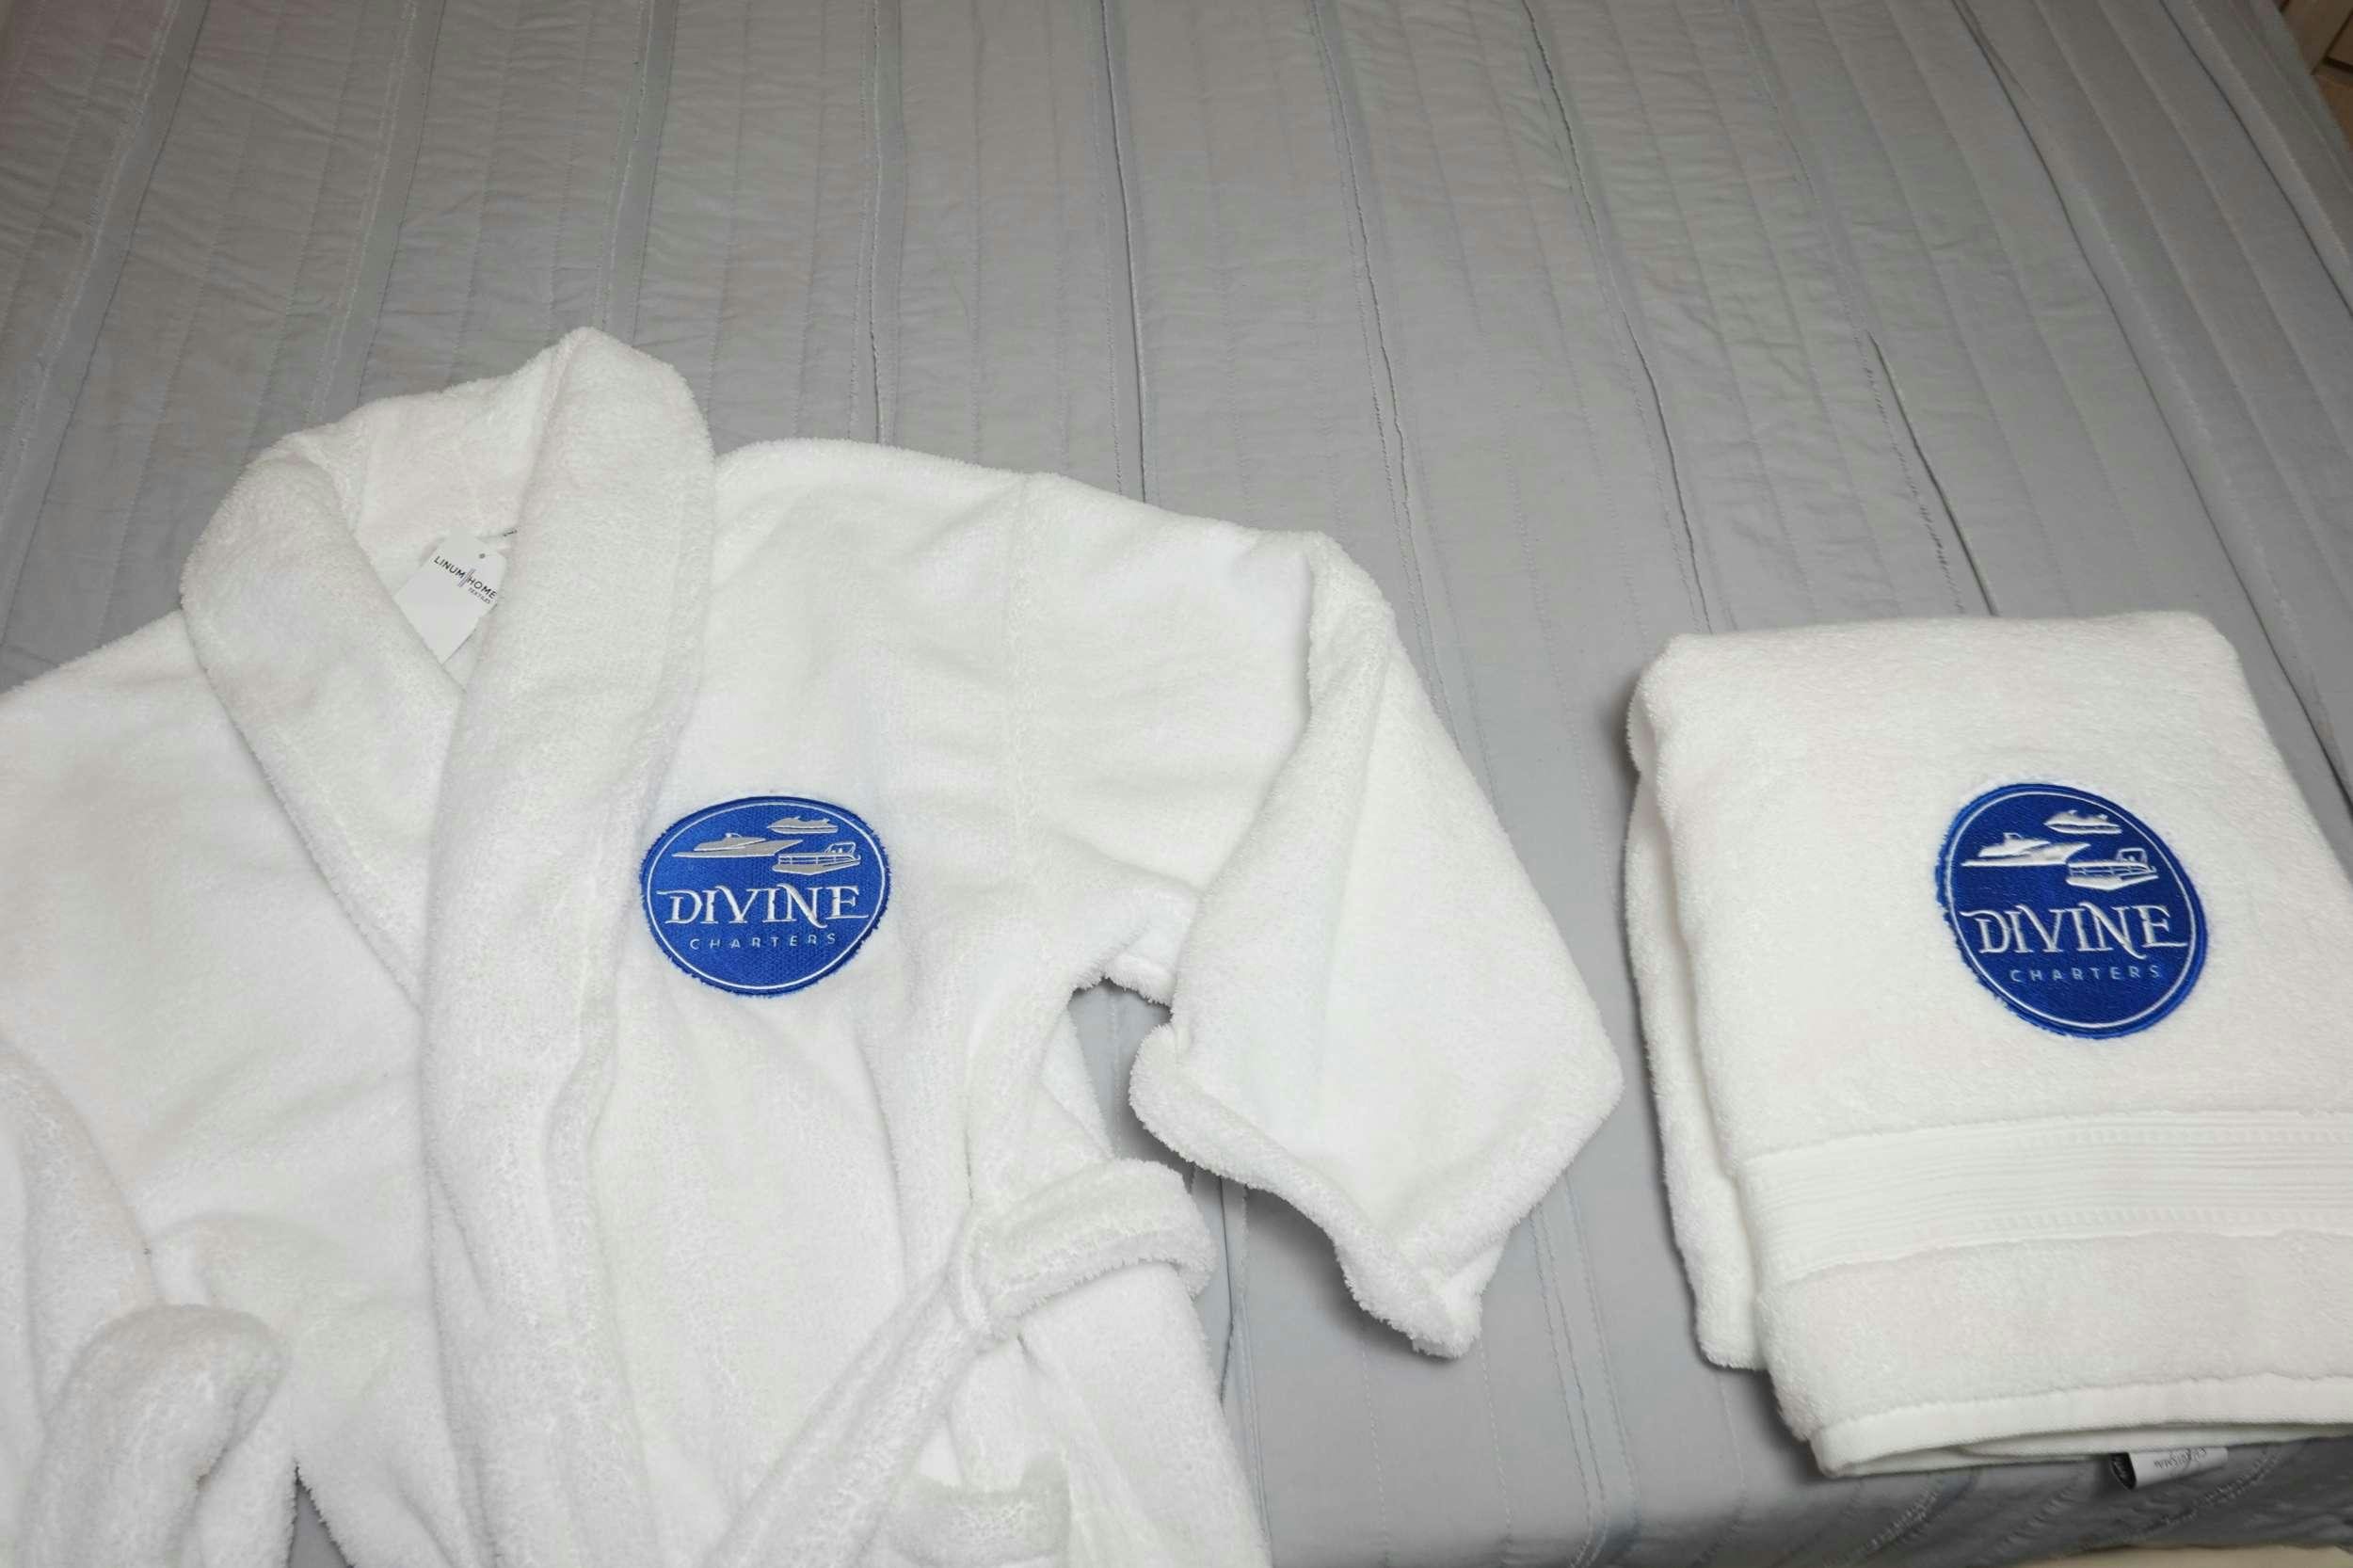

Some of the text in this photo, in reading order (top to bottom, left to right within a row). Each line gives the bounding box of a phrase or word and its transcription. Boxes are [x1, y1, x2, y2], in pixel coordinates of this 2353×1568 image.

[433, 555, 498, 600] LINUM HOME
[656, 883, 870, 928] DIVINE
[689, 933, 837, 951] CHARTERS
[1959, 901, 2189, 960] DIVINE
[2009, 965, 2163, 983] CHARTERS
